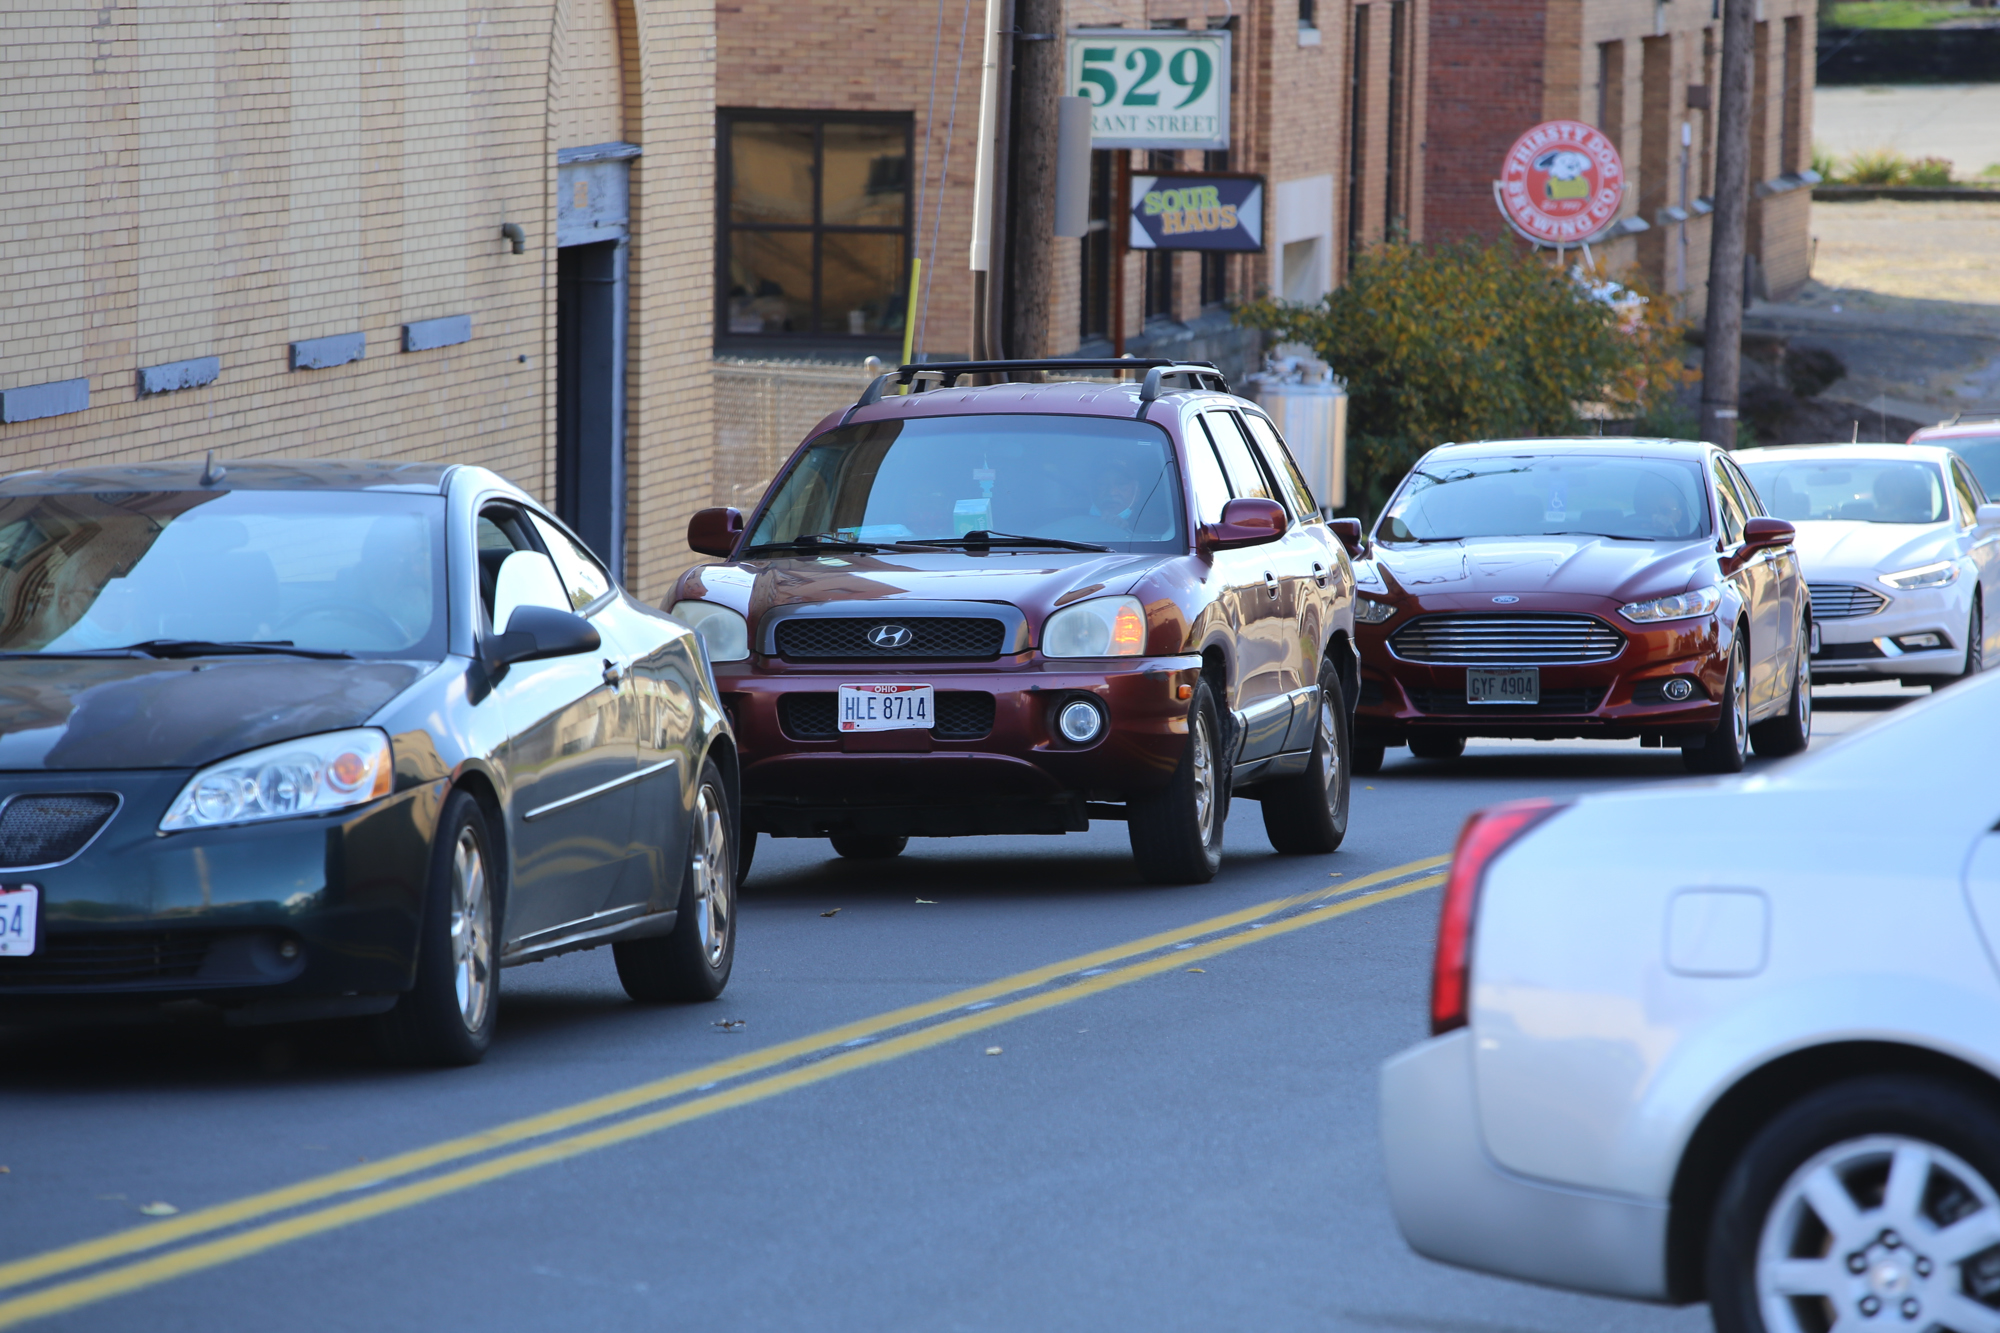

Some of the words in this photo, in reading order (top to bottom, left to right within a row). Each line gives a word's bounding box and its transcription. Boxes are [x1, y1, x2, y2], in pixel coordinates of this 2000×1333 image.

[1078, 47, 1213, 110] 529
[1091, 115, 1139, 133] RANT
[1146, 115, 1217, 133] STREET
[1510, 125, 1589, 174] THIRSTY
[1587, 137, 1618, 178] DOG
[1144, 185, 1221, 215] SOUR
[1508, 181, 1593, 236] BREWING
[1591, 183, 1619, 218] CO.
[1162, 204, 1238, 235] HAUS
[874, 685, 898, 693] OHIO
[1472, 677, 1496, 695] GYF
[1501, 677, 1533, 695] 4904
[845, 697, 877, 720] HLE
[883, 697, 926, 720] 8714
